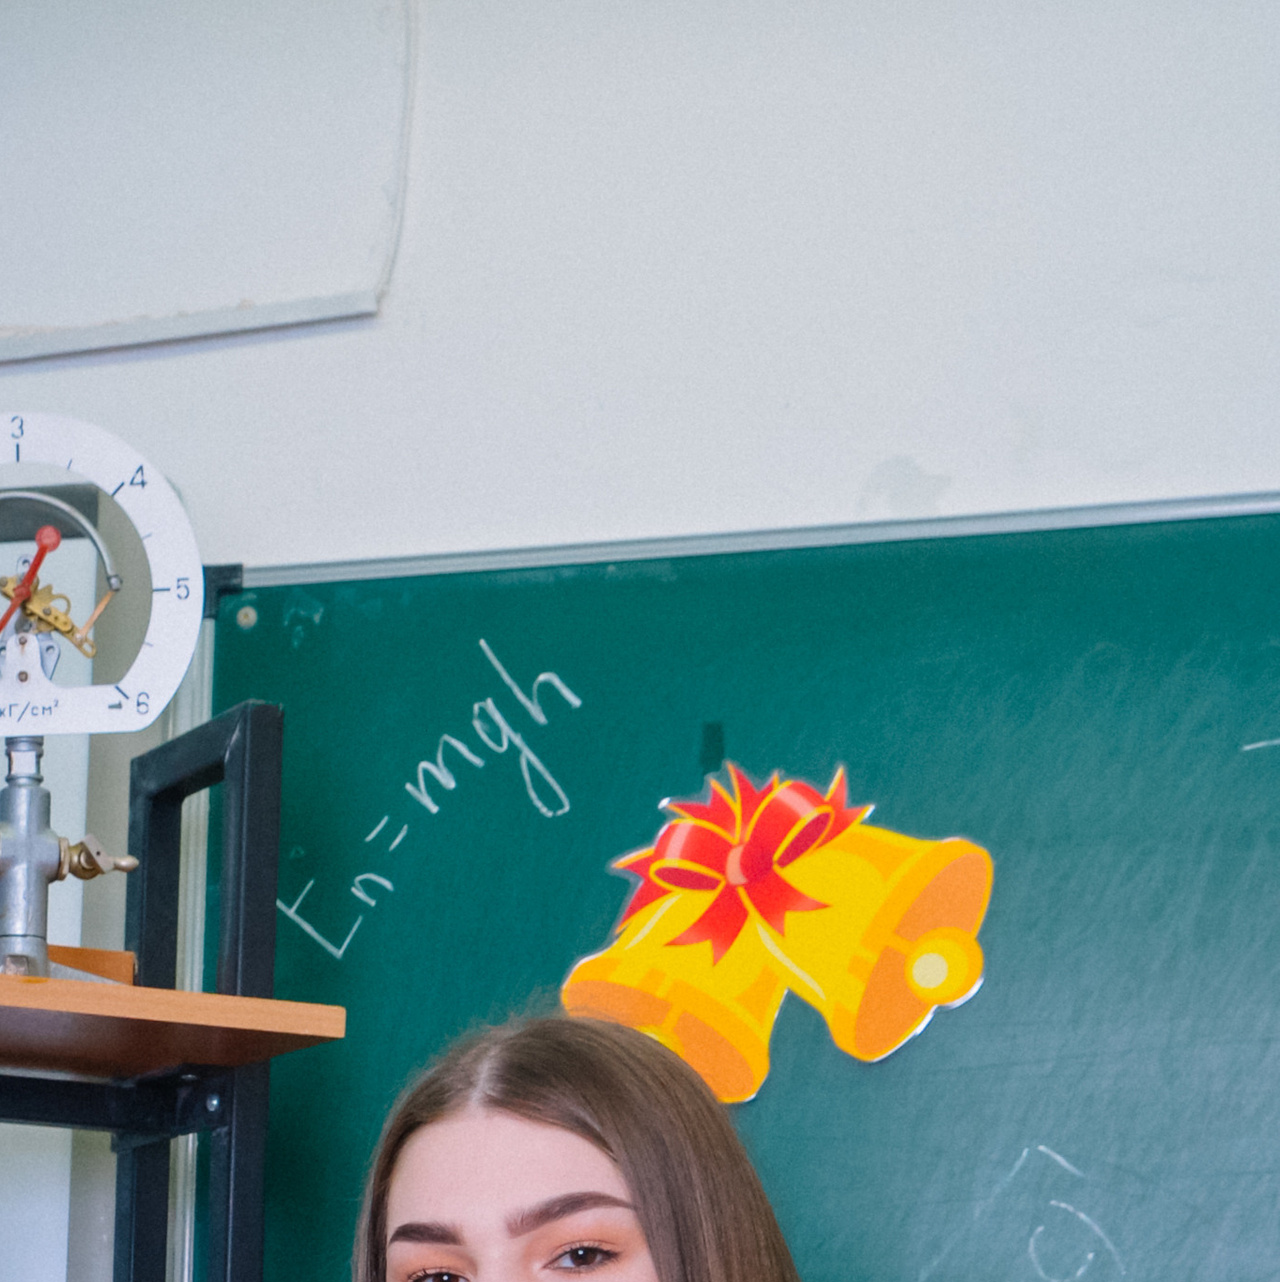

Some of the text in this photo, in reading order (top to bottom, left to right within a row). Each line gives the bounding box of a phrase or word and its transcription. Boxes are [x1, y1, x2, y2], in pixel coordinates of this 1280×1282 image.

[10, 415, 25, 439] 3
[129, 465, 148, 489] 4
[176, 577, 191, 601] 5
[136, 692, 150, 715] 6
